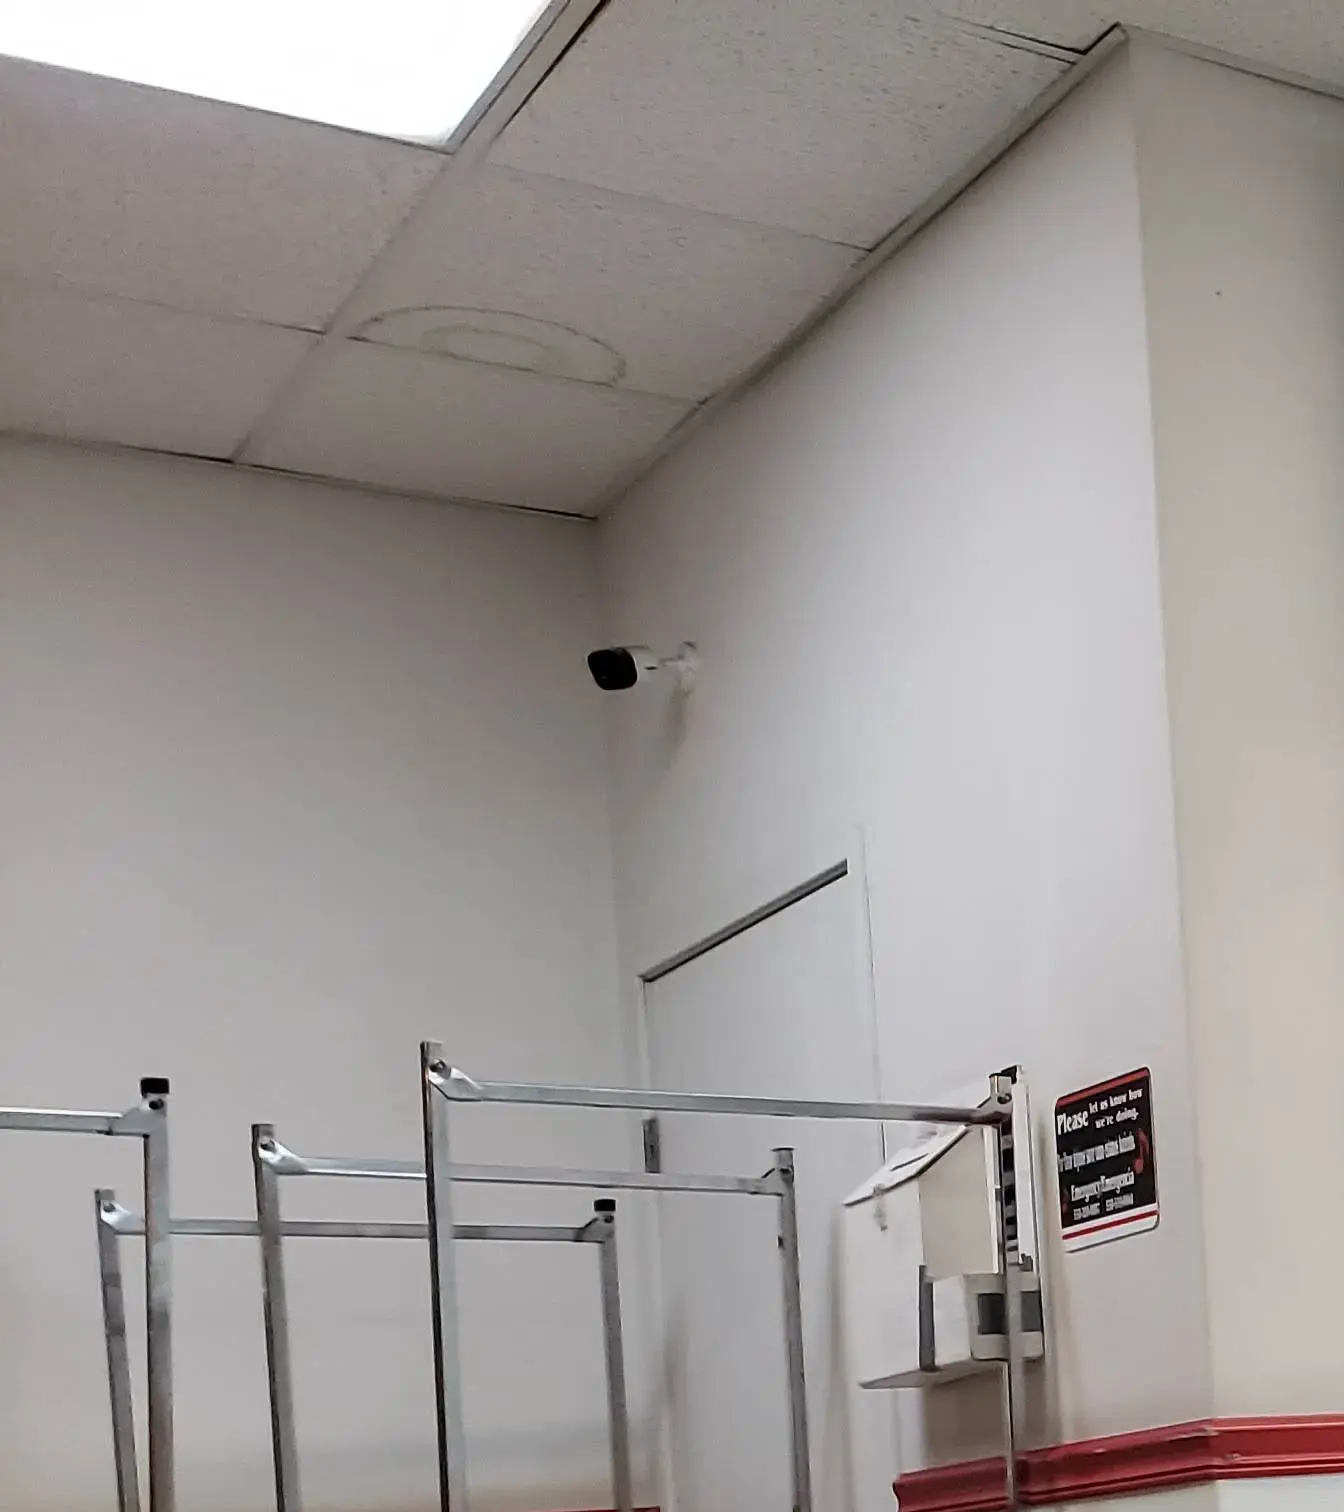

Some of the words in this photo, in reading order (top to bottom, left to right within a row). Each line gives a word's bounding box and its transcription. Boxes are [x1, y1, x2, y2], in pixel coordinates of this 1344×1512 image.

[1089, 1101, 1098, 1114] let
[1100, 1100, 1108, 1111] us
[1056, 1110, 1089, 1136] Please
